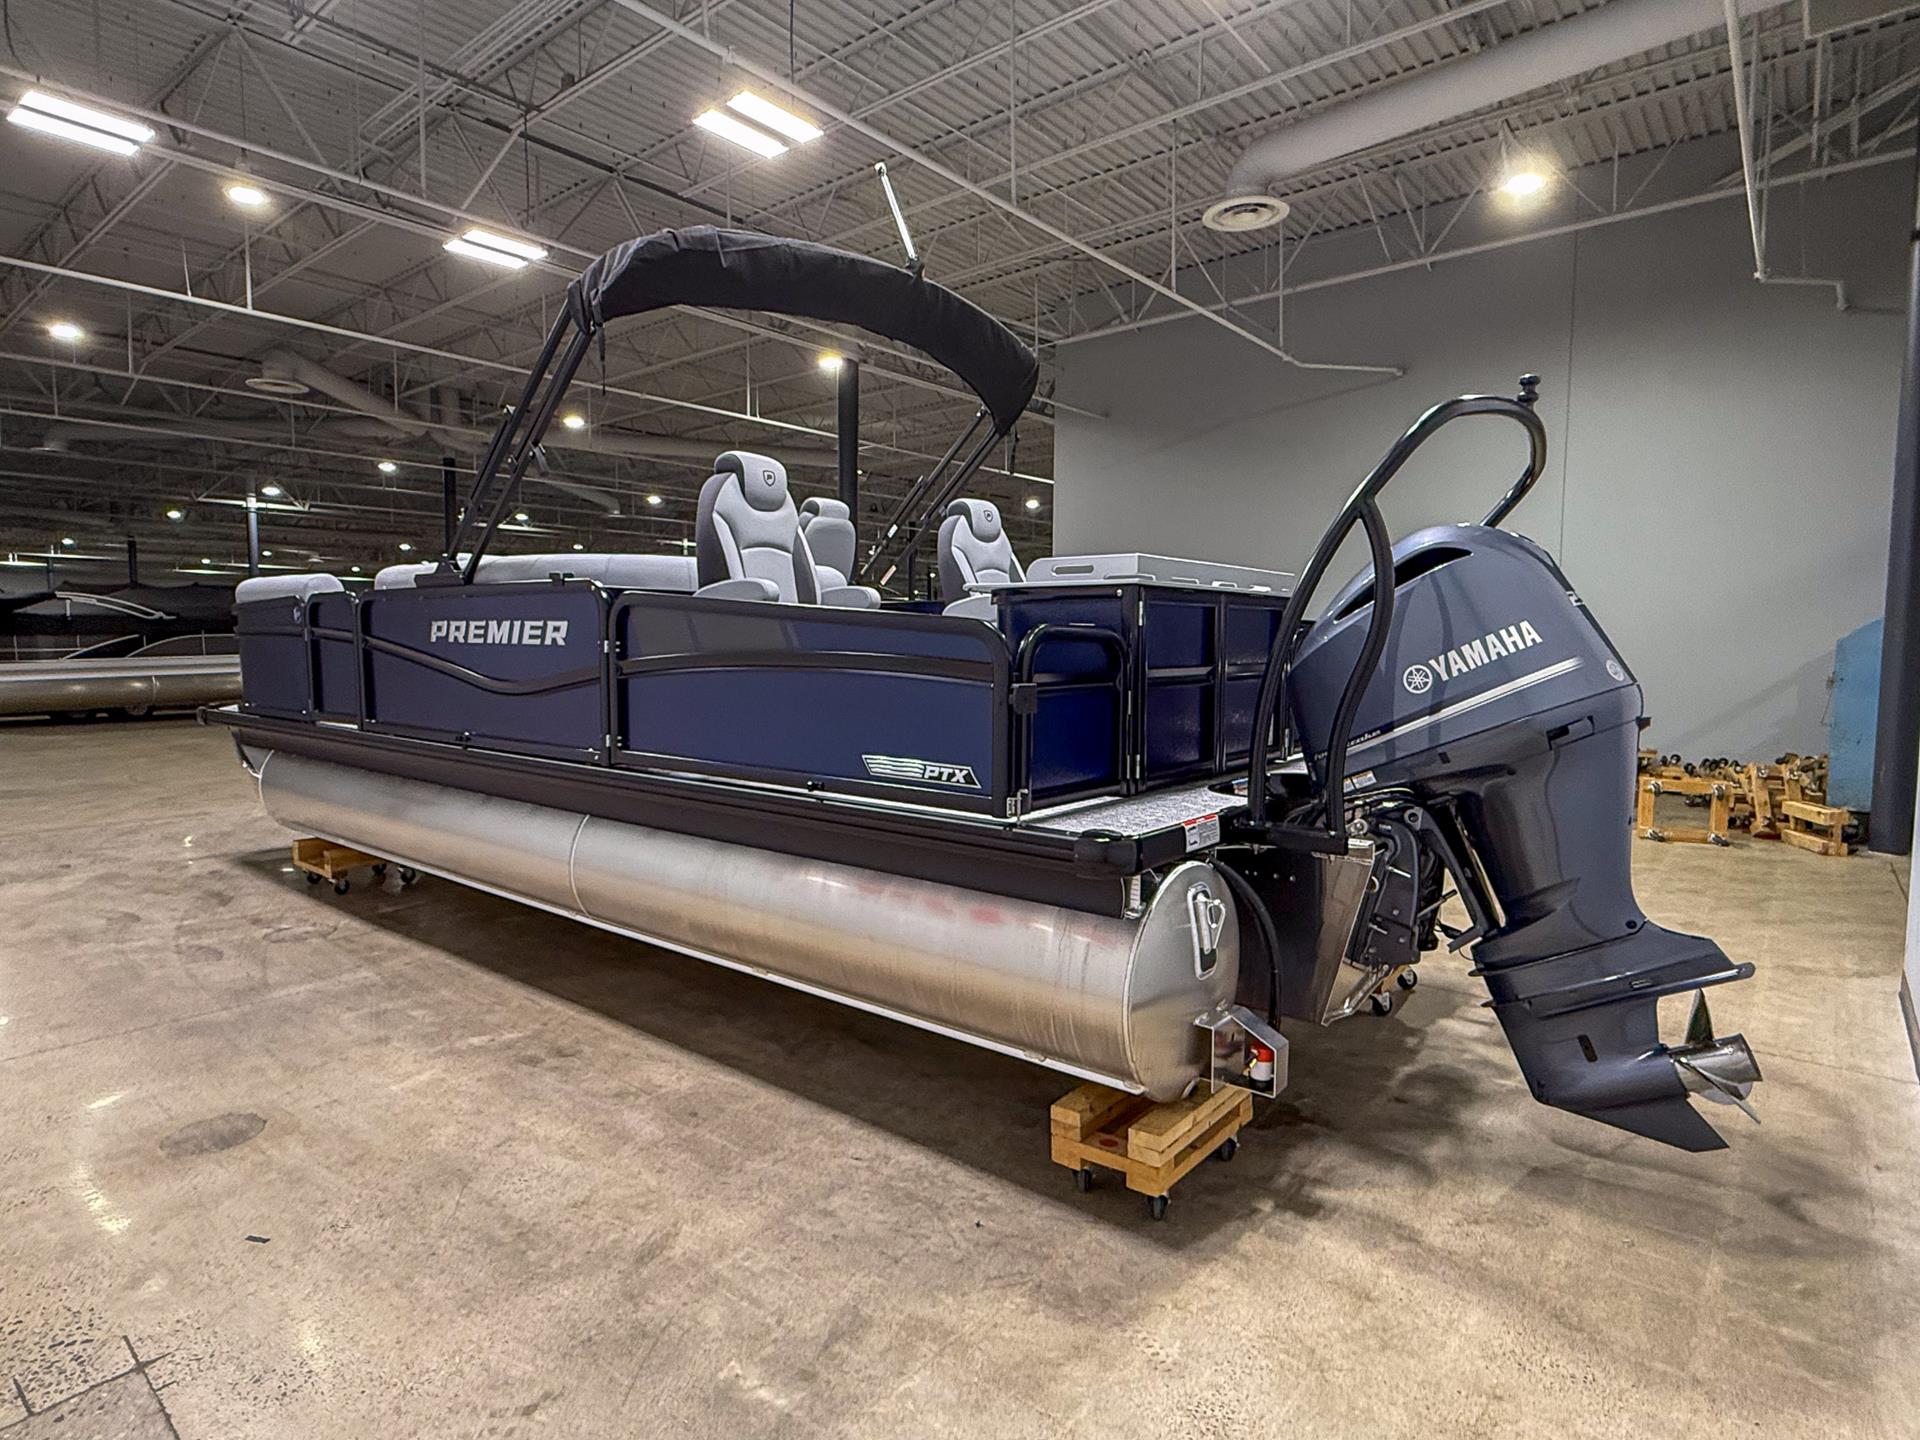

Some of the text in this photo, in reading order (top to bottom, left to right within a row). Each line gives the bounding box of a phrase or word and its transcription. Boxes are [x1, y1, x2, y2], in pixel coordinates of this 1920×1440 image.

[430, 619, 569, 646] PREMIER
[1428, 620, 1543, 681] YAMAHA
[923, 765, 969, 783] PTX
